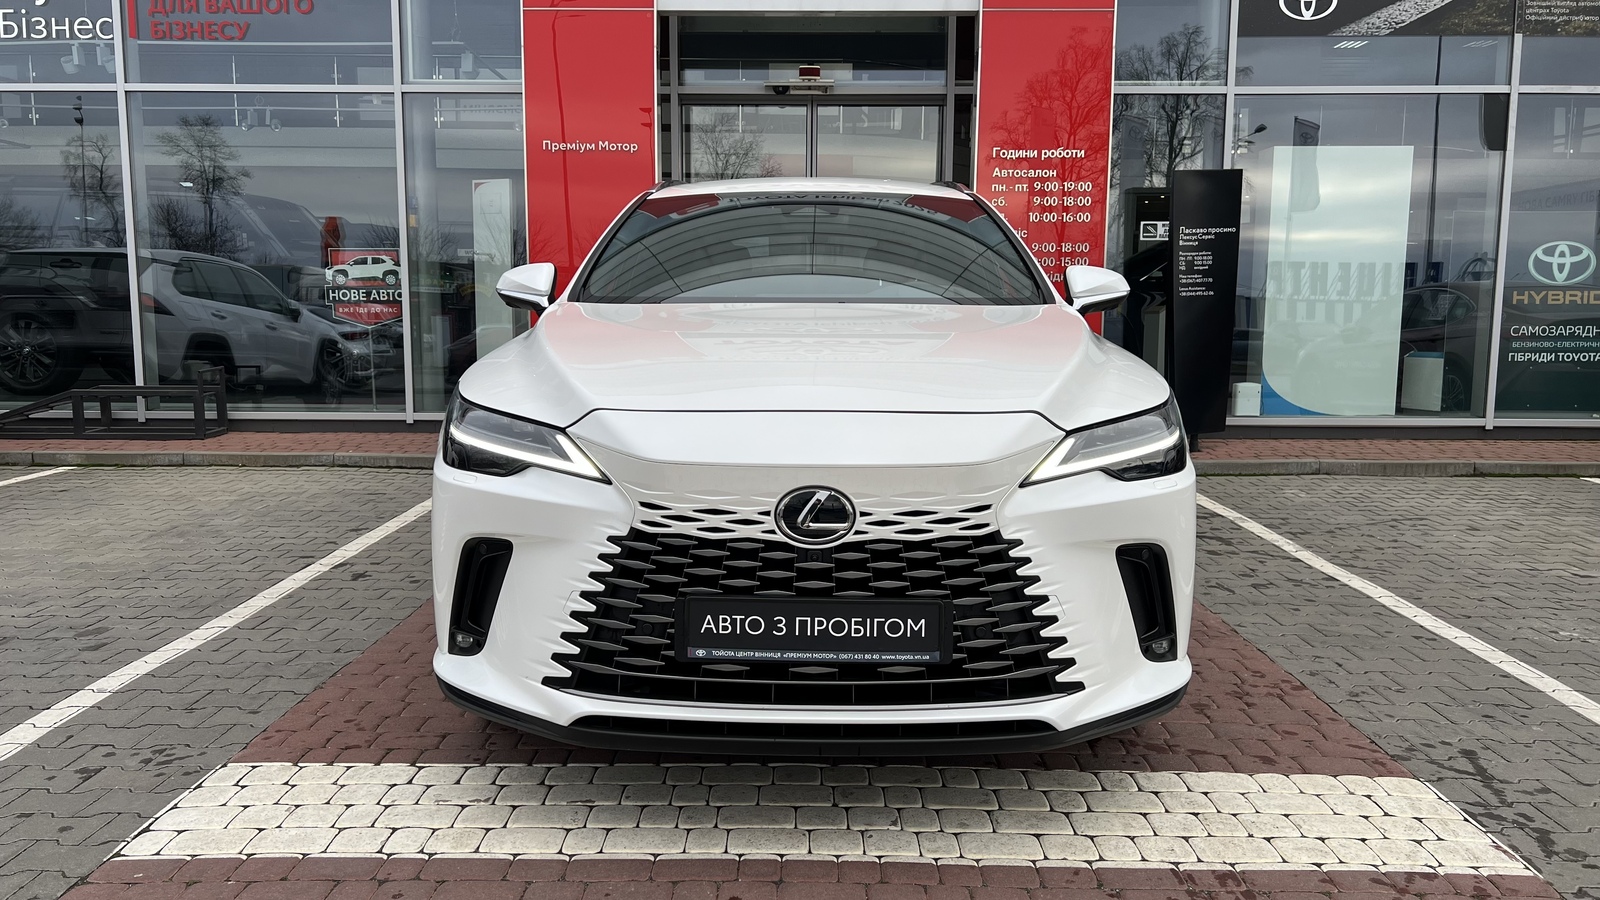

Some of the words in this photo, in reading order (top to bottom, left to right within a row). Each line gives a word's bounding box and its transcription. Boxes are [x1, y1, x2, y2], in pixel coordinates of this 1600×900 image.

[147, 0, 199, 16] ДЛЯ
[205, 0, 314, 15] ВАШОГО
[0, 8, 114, 39] Бізнес
[150, 20, 250, 40] БІЗНЕСУ
[542, 140, 595, 153] Преміум
[598, 140, 639, 152] Мотор
[992, 147, 1038, 160] Години
[1041, 147, 1085, 160] роботи
[992, 167, 1057, 178] Автосалон
[1033, 182, 1092, 192] 9:00-19:00
[991, 196, 1008, 206] сб.
[1033, 196, 1092, 206] 9:00-18:00
[1029, 212, 1091, 222] 10:00-16:00
[1031, 243, 1090, 253] 9:00-18:00
[329, 289, 367, 300] НОВЕ
[370, 289, 402, 300] АВТО
[1512, 290, 1600, 305] HYBRID
[1508, 352, 1555, 363] ГІБРИДИ
[700, 614, 765, 635] АВТО
[772, 616, 787, 636] З
[795, 617, 926, 638] ПРОБІГОМ
[711, 649, 735, 657] ТОЙОТА
[735, 650, 754, 658] ЦЕНТР
[838, 652, 854, 660] (067)
[881, 653, 930, 661] www.toyota.vn.ua
